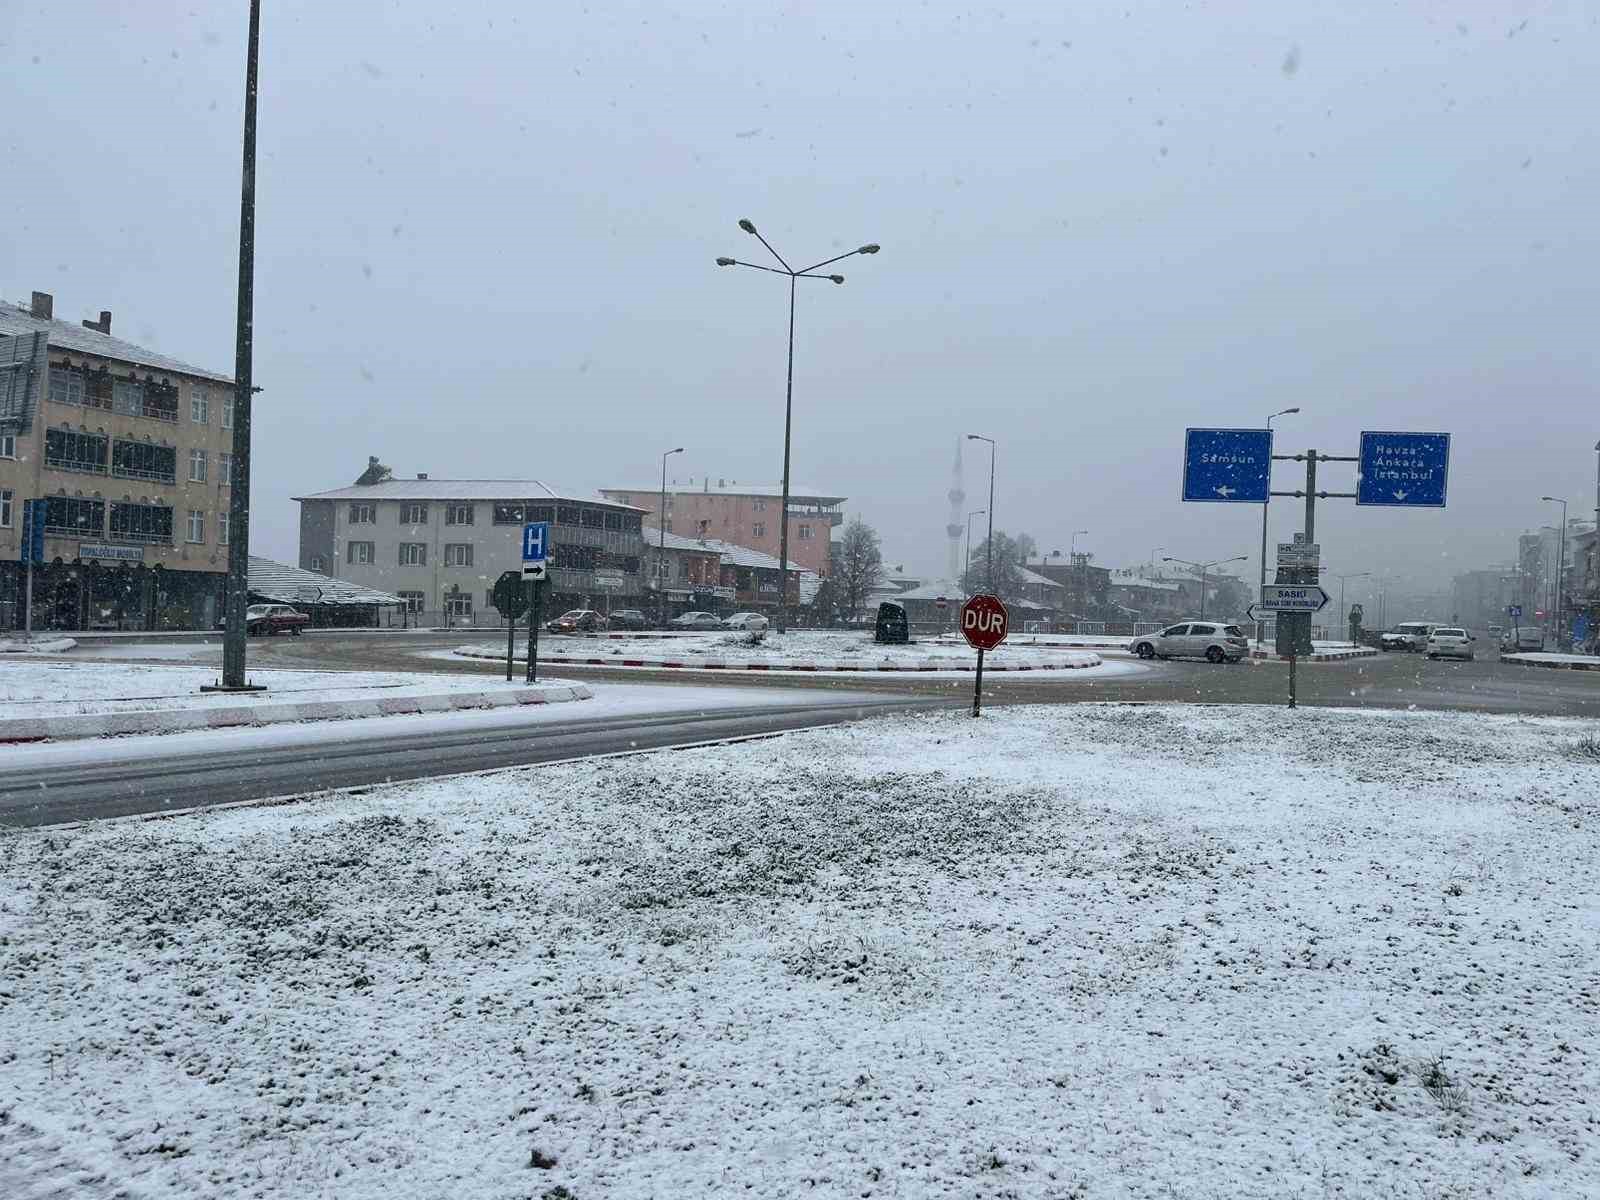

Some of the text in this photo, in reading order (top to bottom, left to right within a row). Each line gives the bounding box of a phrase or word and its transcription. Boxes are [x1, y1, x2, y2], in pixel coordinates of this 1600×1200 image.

[1376, 445, 1416, 455] Havza
[1202, 453, 1255, 464] Samsun
[1376, 457, 1424, 467] Ankara
[528, 528, 543, 555] H
[965, 610, 1004, 634] DUR
